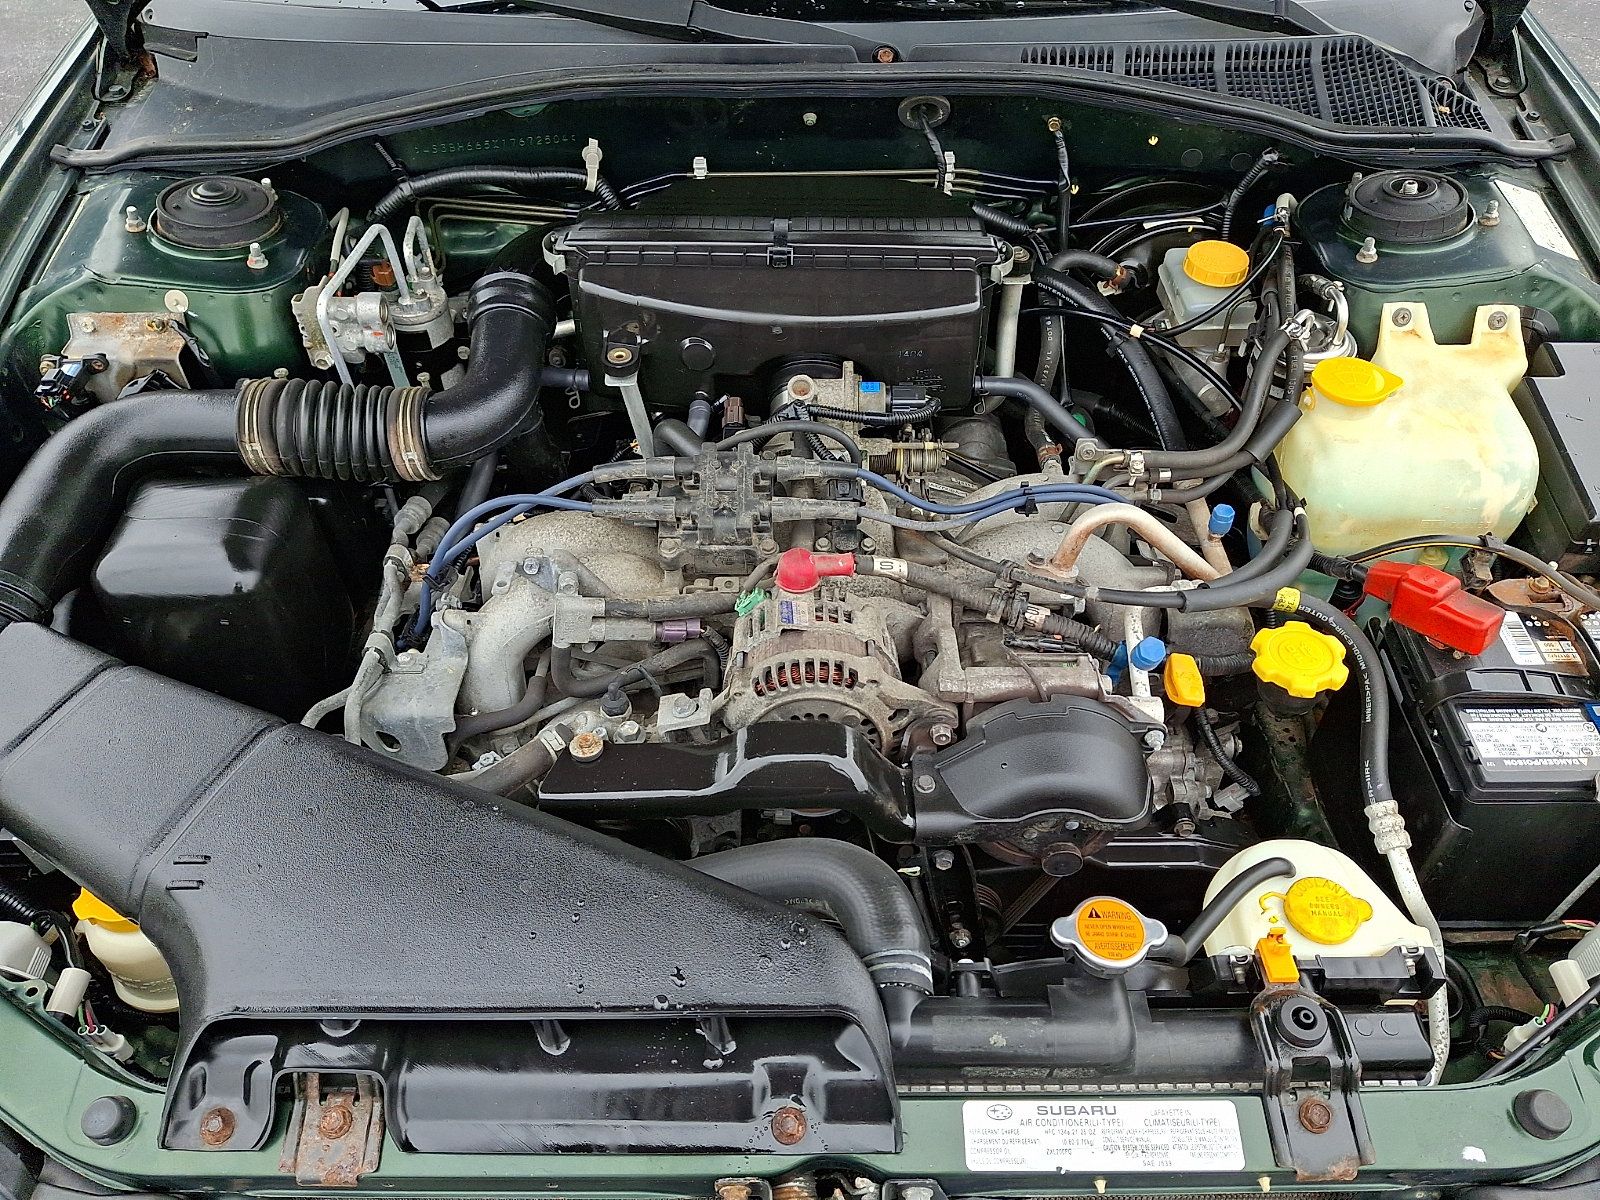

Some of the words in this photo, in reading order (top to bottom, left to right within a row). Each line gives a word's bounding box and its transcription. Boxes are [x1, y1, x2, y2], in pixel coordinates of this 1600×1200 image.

[1290, 355, 1298, 373] FUEL
[1363, 672, 1372, 723] INNER>PA<
[1503, 758, 1580, 767] DANGER/POISON
[1101, 911, 1132, 920] WARNING
[1094, 943, 1134, 951] AVERTISSEMENT
[1036, 1105, 1117, 1116] SUBARU
[1150, 1108, 1183, 1117] LAFAYETTE
[1019, 1118, 1032, 1127] AIR
